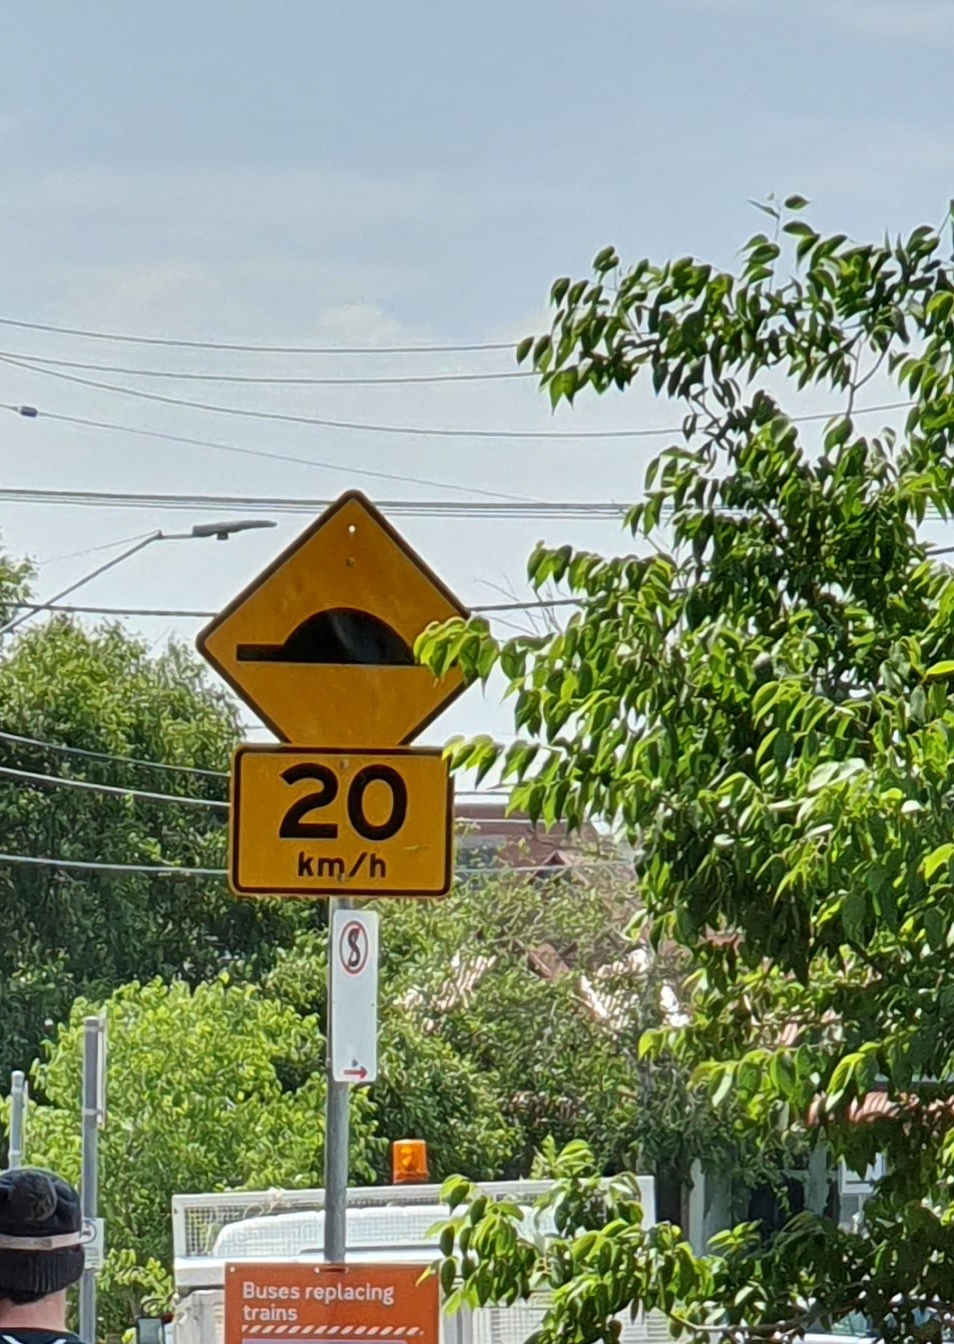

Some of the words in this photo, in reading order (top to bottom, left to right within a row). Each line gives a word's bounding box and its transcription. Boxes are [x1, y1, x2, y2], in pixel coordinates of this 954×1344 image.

[279, 763, 408, 841] 20
[298, 851, 387, 879] km/h
[242, 1281, 300, 1299] Buses
[305, 1283, 394, 1305] replacing
[243, 1303, 298, 1321] trains
